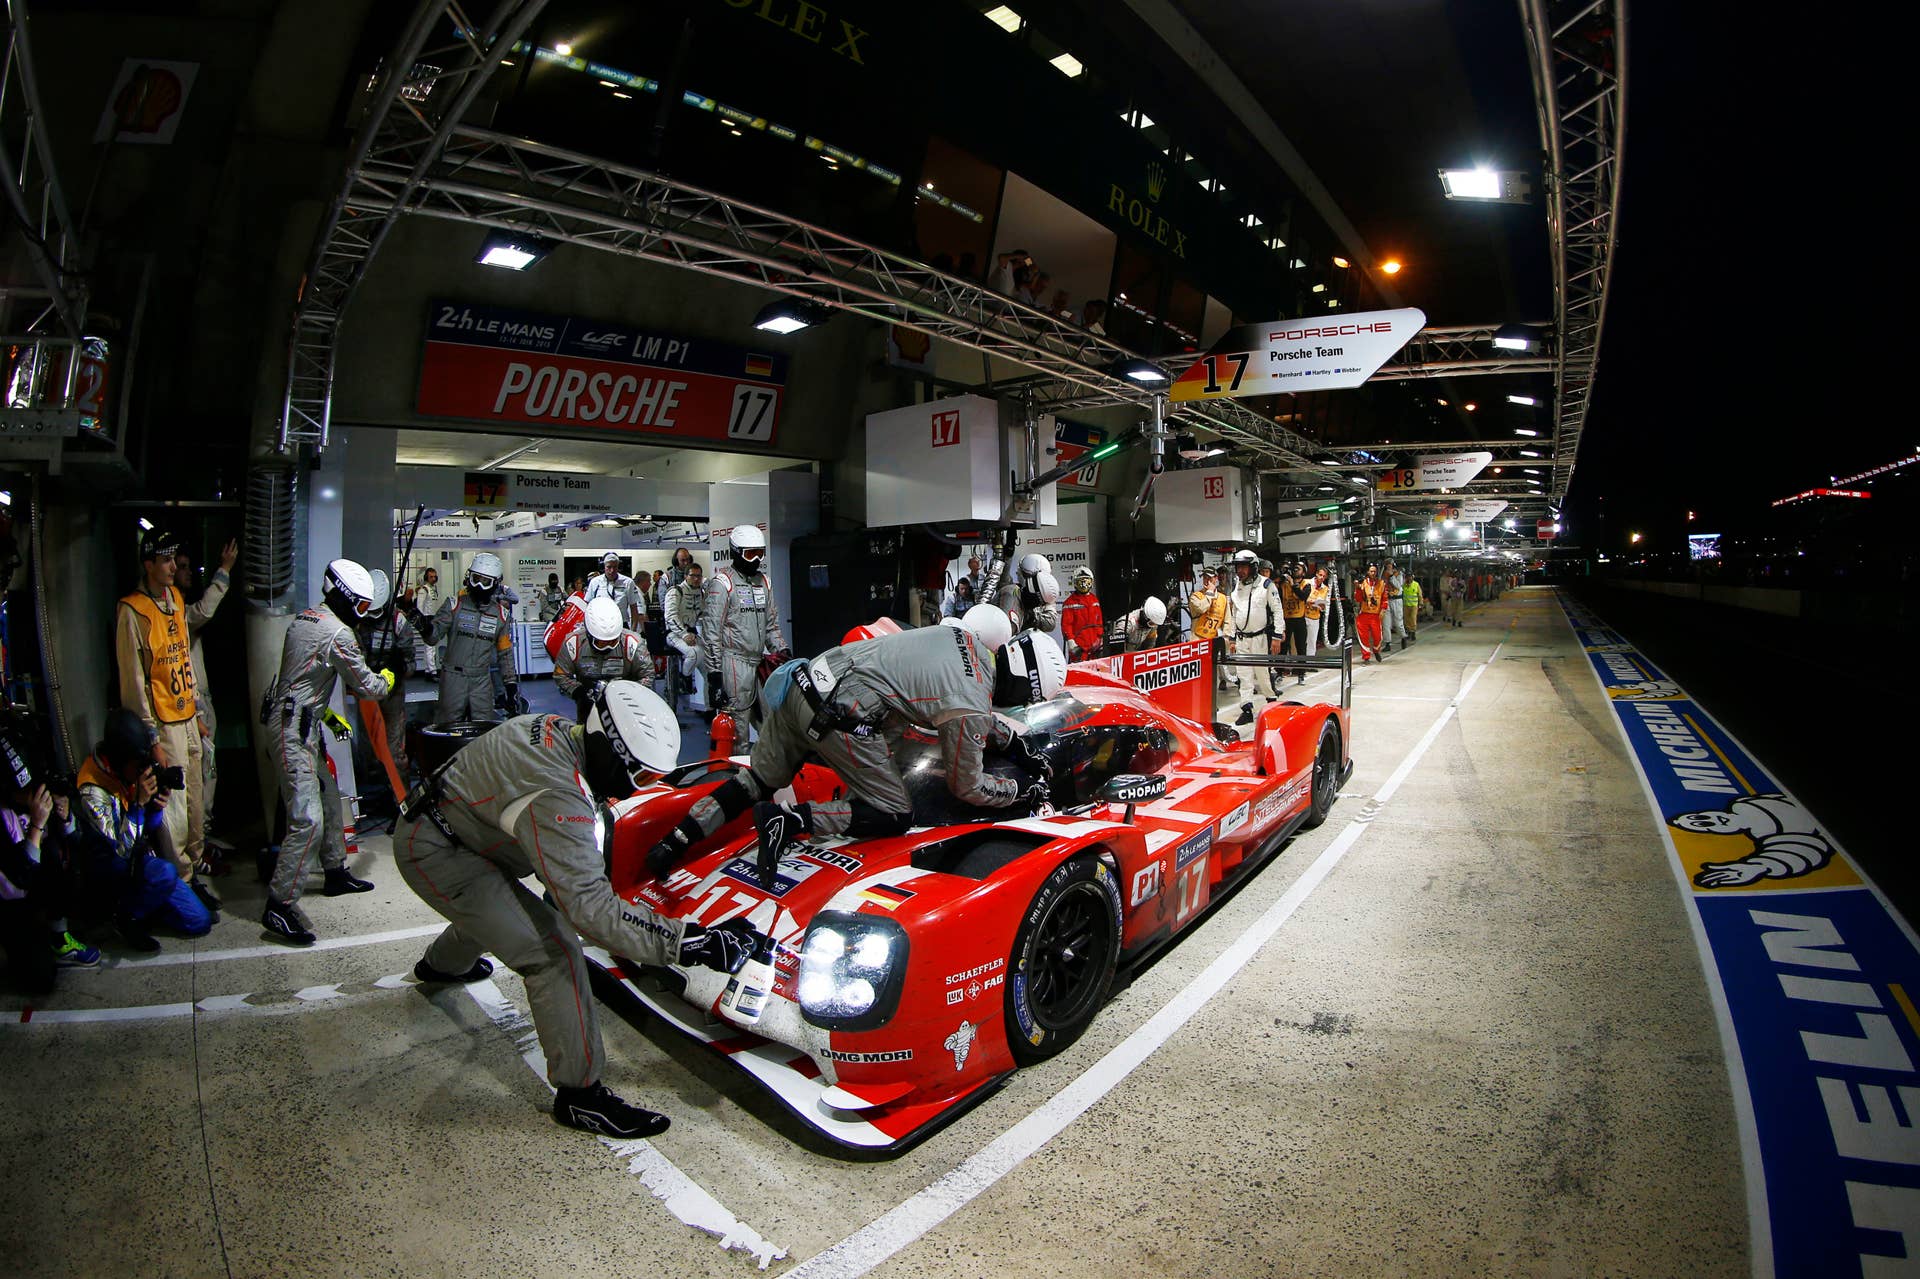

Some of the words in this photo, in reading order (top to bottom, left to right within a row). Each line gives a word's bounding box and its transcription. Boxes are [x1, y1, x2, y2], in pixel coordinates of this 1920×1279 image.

[724, 0, 871, 64] LEX
[1108, 183, 1187, 258] ROLEX
[475, 319, 498, 333] LE
[500, 322, 556, 340] MANS
[582, 331, 627, 347] WEC
[1269, 321, 1392, 342] PORSCHE
[632, 336, 664, 361] LM
[664, 341, 690, 364] P1
[1270, 347, 1313, 362] Porsche
[1315, 345, 1344, 358] Team
[1203, 352, 1250, 394] 17
[1279, 370, 1303, 379] Bernhard
[1312, 368, 1332, 377] Hartley
[493, 362, 688, 428] PORSCHE
[732, 389, 774, 435] 17
[933, 412, 959, 445] 17
[517, 475, 560, 487] Porsche
[563, 477, 590, 489] Team
[1204, 478, 1224, 498] 18
[1392, 470, 1415, 488] 18
[476, 483, 499, 504] 17
[1027, 536, 1086, 544] PORSCHE
[1056, 552, 1086, 561] MORI
[335, 578, 356, 602] uvex
[958, 646, 974, 677] MORI
[1111, 656, 1124, 679] HY
[1134, 641, 1209, 669] PORSCHE
[1600, 652, 1645, 681] MICHELIN
[1028, 669, 1041, 702] uvex
[1135, 669, 1167, 691] DMG
[1170, 660, 1200, 683] MORI
[601, 710, 635, 765] uvex
[1633, 703, 1739, 794] MICHELIN
[1118, 780, 1166, 800] CHOPARD
[1189, 843, 1197, 853] LE
[1196, 835, 1211, 849] MANS
[800, 845, 861, 873] MORI
[1138, 869, 1156, 899] P1
[1177, 857, 1207, 921] 17
[680, 886, 760, 928] 17
[622, 911, 653, 932] DMG
[945, 957, 1004, 985] SCHAEFFLER
[984, 973, 1004, 990] FAG
[821, 1048, 860, 1062] DMG
[864, 1051, 912, 1062] MORI
